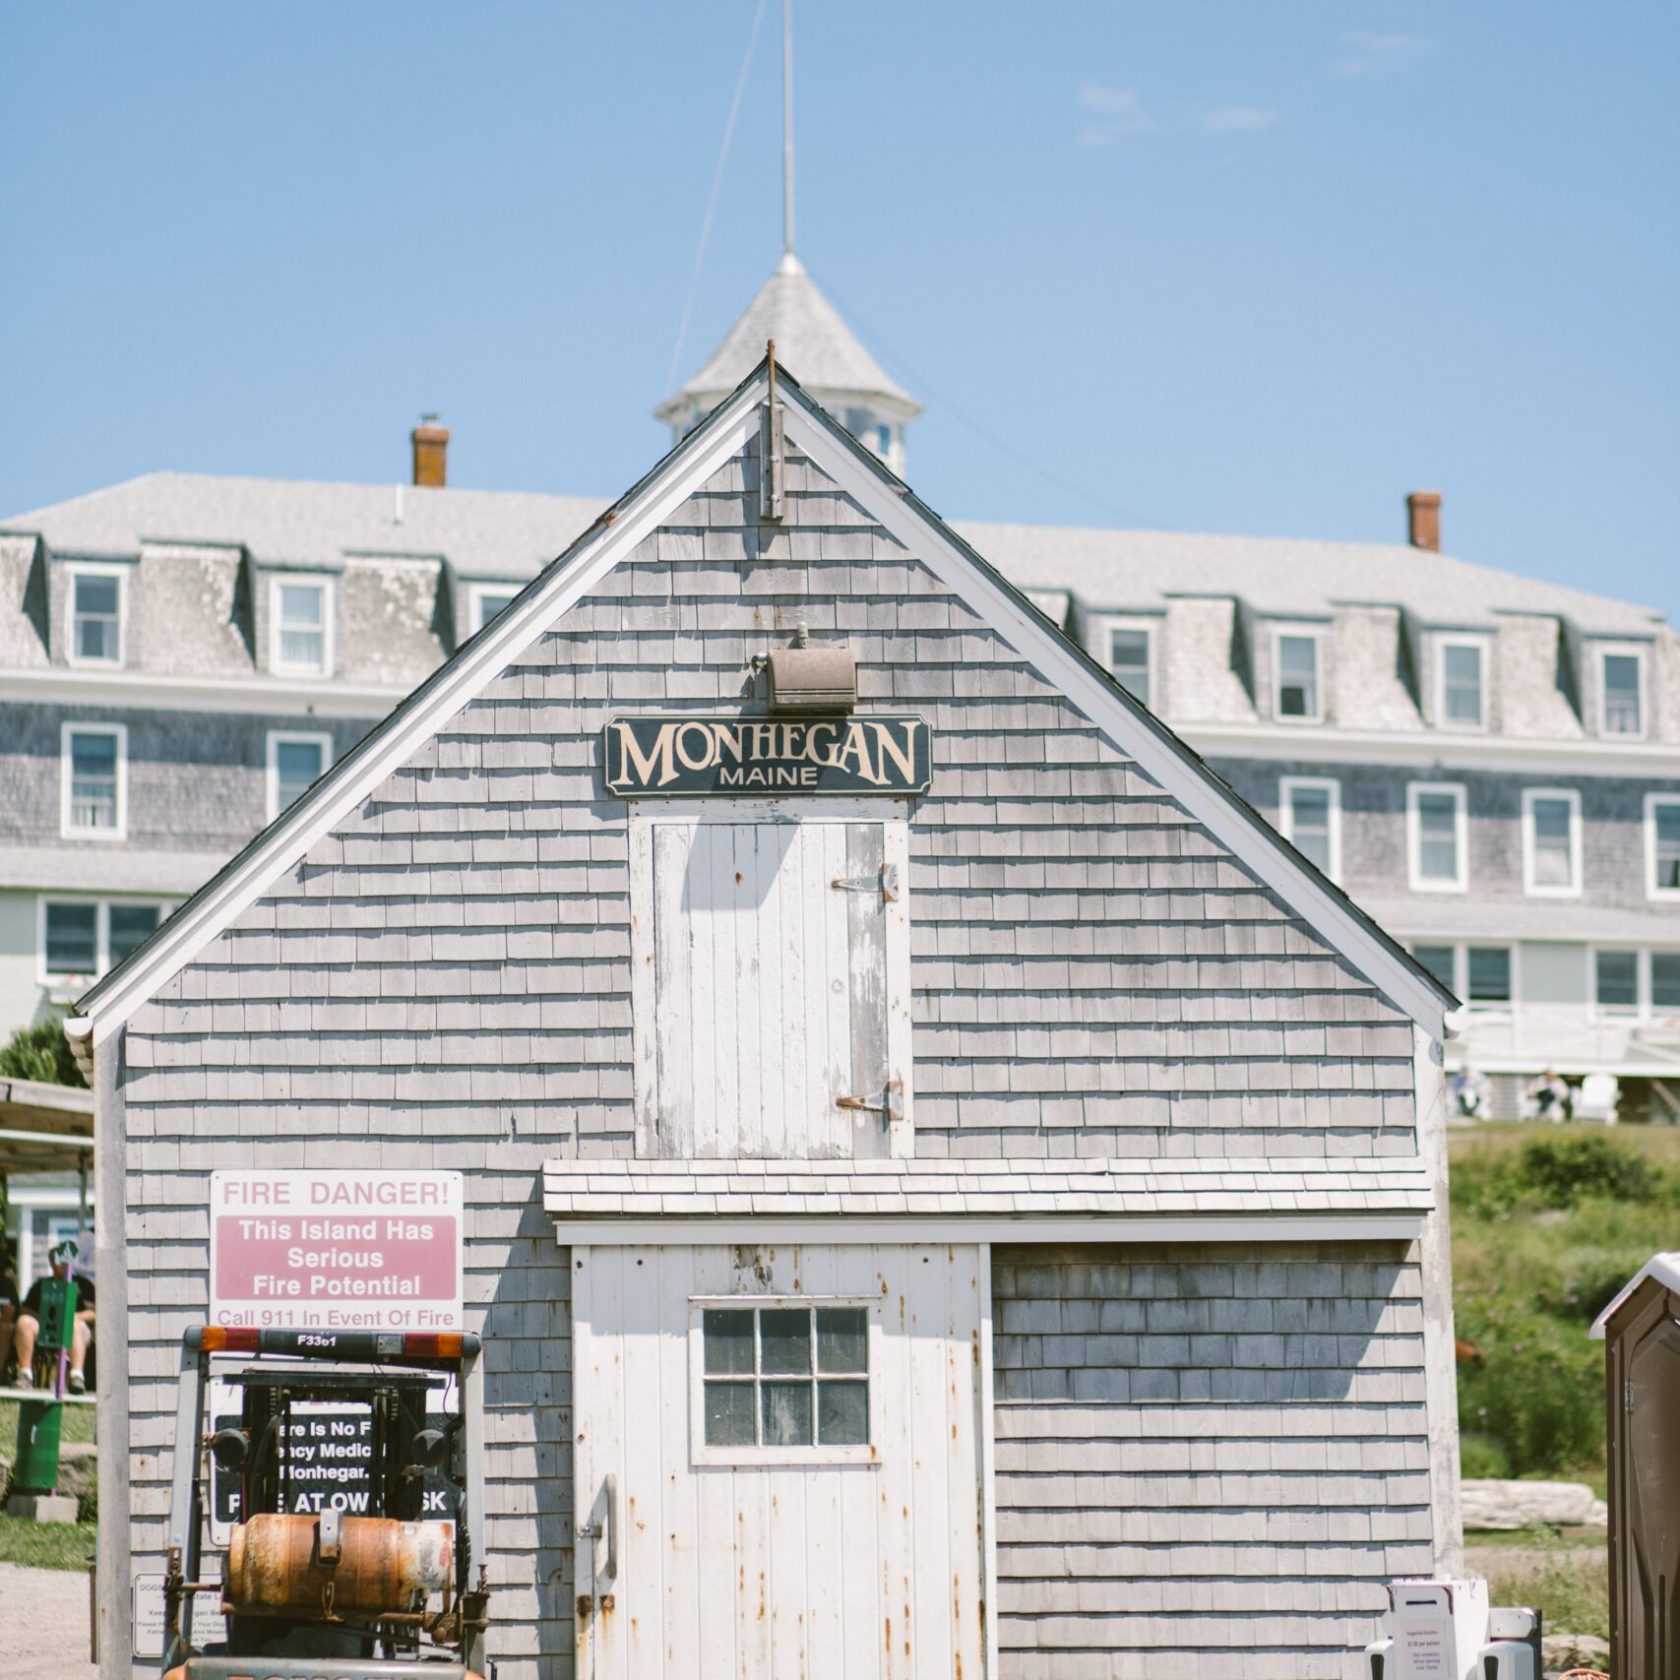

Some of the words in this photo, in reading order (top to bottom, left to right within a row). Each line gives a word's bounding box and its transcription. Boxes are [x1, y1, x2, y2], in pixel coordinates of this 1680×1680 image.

[611, 720, 920, 787] MONHEGAN
[720, 766, 817, 785] MAINE
[224, 1181, 291, 1205] FIRE
[310, 1181, 449, 1205] DANGER!
[238, 1219, 292, 1241] This
[301, 1219, 377, 1241] Island
[386, 1219, 434, 1241] Has
[288, 1247, 384, 1269] Serious
[253, 1275, 301, 1296] Fire
[310, 1275, 420, 1296] Potential
[217, 1309, 255, 1326] Call
[261, 1309, 295, 1326] 911
[303, 1309, 321, 1326] In
[328, 1309, 382, 1326] Event
[388, 1309, 412, 1326] Of
[417, 1309, 454, 1326] Fire
[310, 1421, 326, 1436] Is
[330, 1421, 356, 1436] No
[294, 1492, 325, 1513] AT
